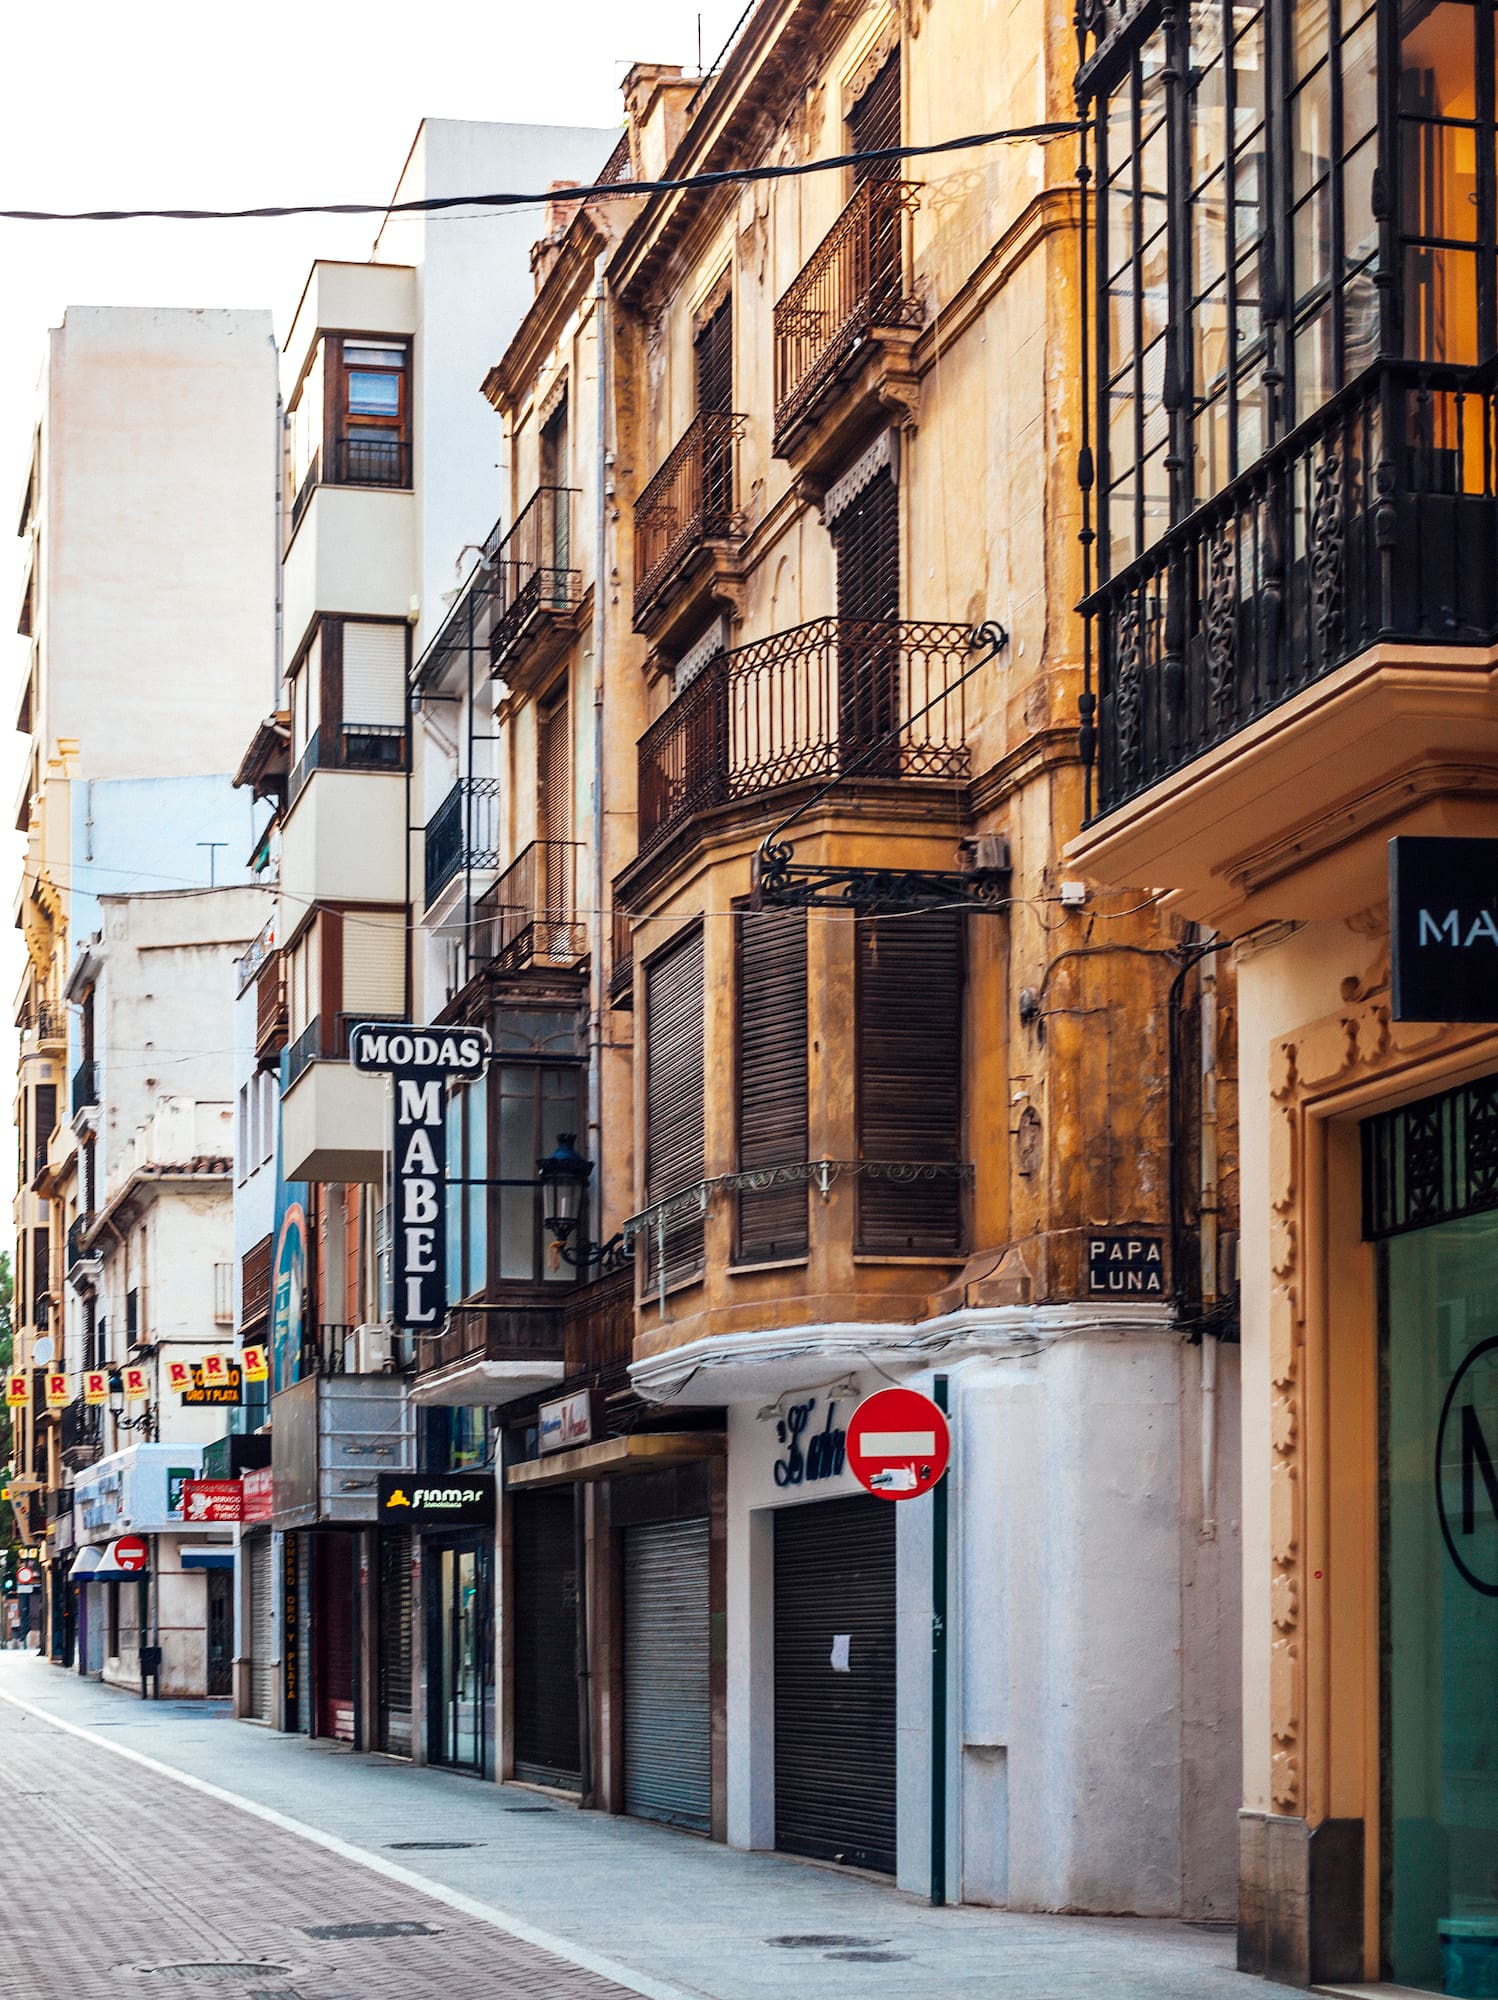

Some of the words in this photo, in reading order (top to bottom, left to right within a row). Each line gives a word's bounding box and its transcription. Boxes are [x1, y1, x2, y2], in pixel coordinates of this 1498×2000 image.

[360, 1033, 481, 1067] MODAS
[398, 1079, 443, 1321] MABEL
[1091, 1241, 1160, 1261] PAPA
[1091, 1270, 1160, 1290] LUNA
[207, 1357, 221, 1373] R
[245, 1351, 259, 1368] R
[128, 1370, 142, 1388] R
[170, 1363, 186, 1381] R
[12, 1379, 25, 1395] R
[51, 1376, 65, 1393] R
[89, 1375, 103, 1392] R
[186, 1389, 205, 1401] ORO
[205, 1389, 213, 1401] Y
[213, 1389, 239, 1401] PLATA
[286, 1594, 296, 1624] ORO
[287, 1632, 294, 1642] Y
[286, 1653, 296, 1700] PLATA
